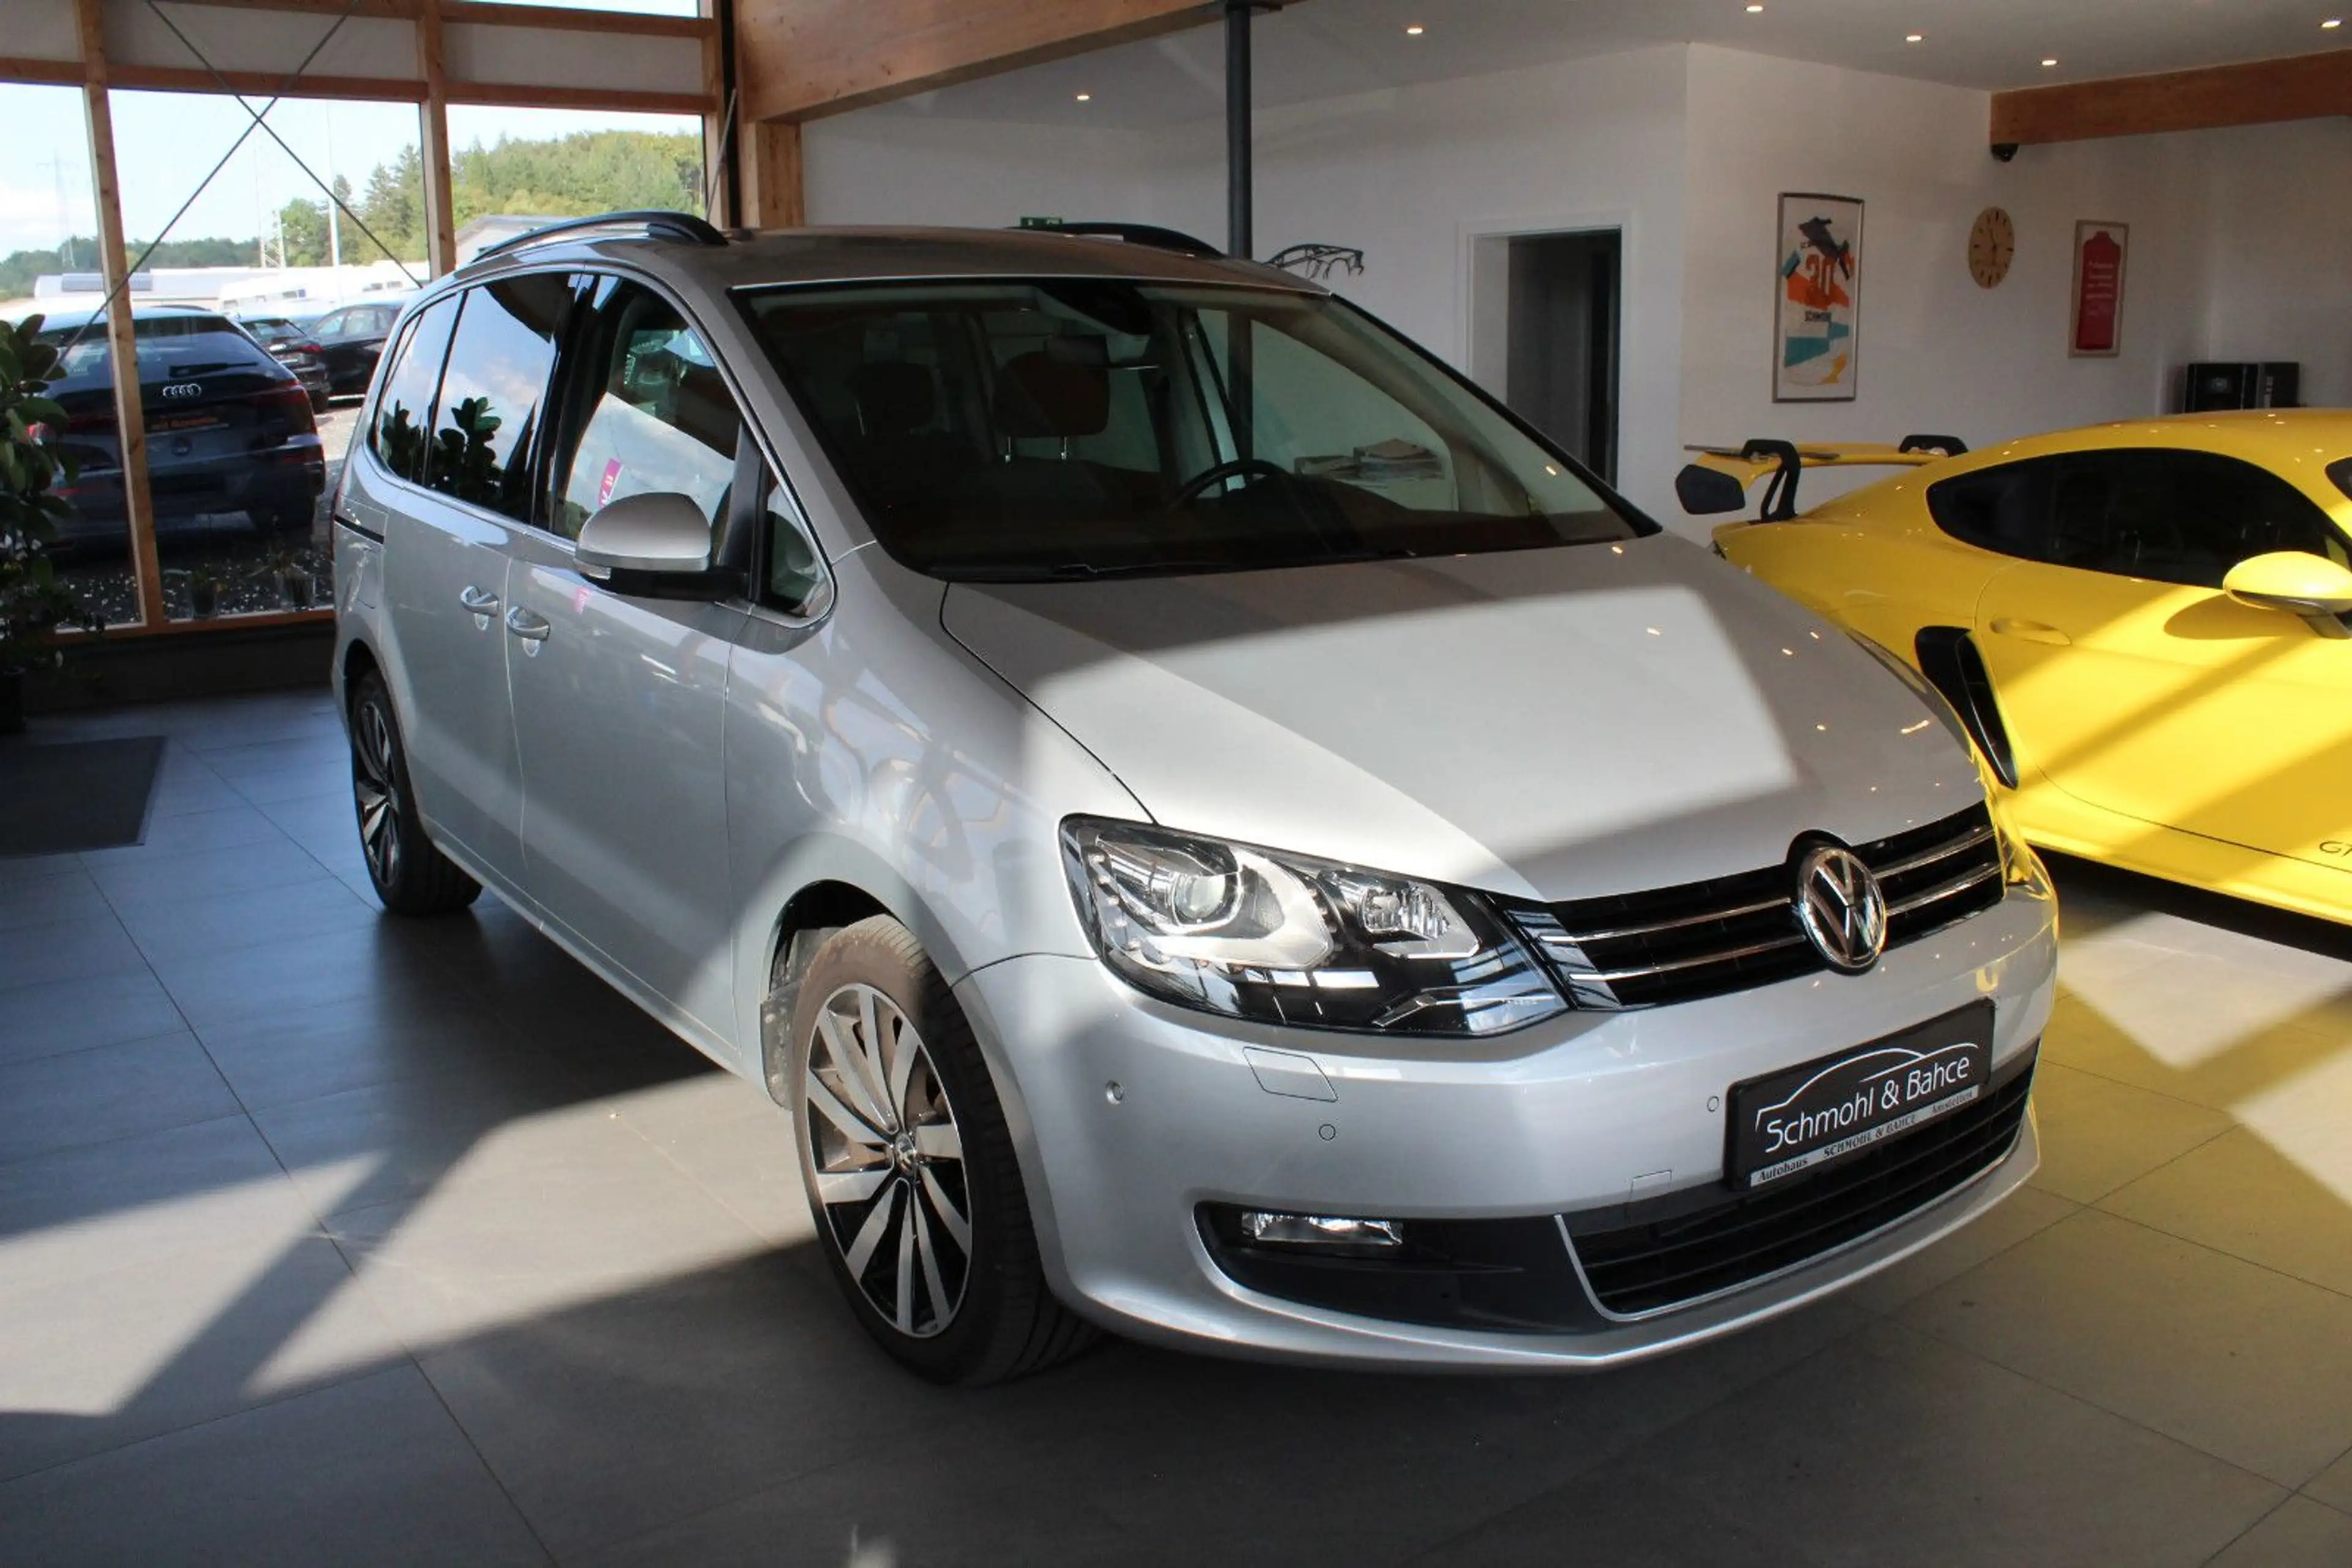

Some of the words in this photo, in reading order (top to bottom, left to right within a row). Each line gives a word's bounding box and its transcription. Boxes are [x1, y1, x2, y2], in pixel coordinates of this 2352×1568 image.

[1765, 1086, 1874, 1153] Schmohl
[1881, 1079, 1899, 1109] &
[1906, 1057, 1970, 1101] Bahce
[1758, 1157, 1808, 1181] Autohaus
